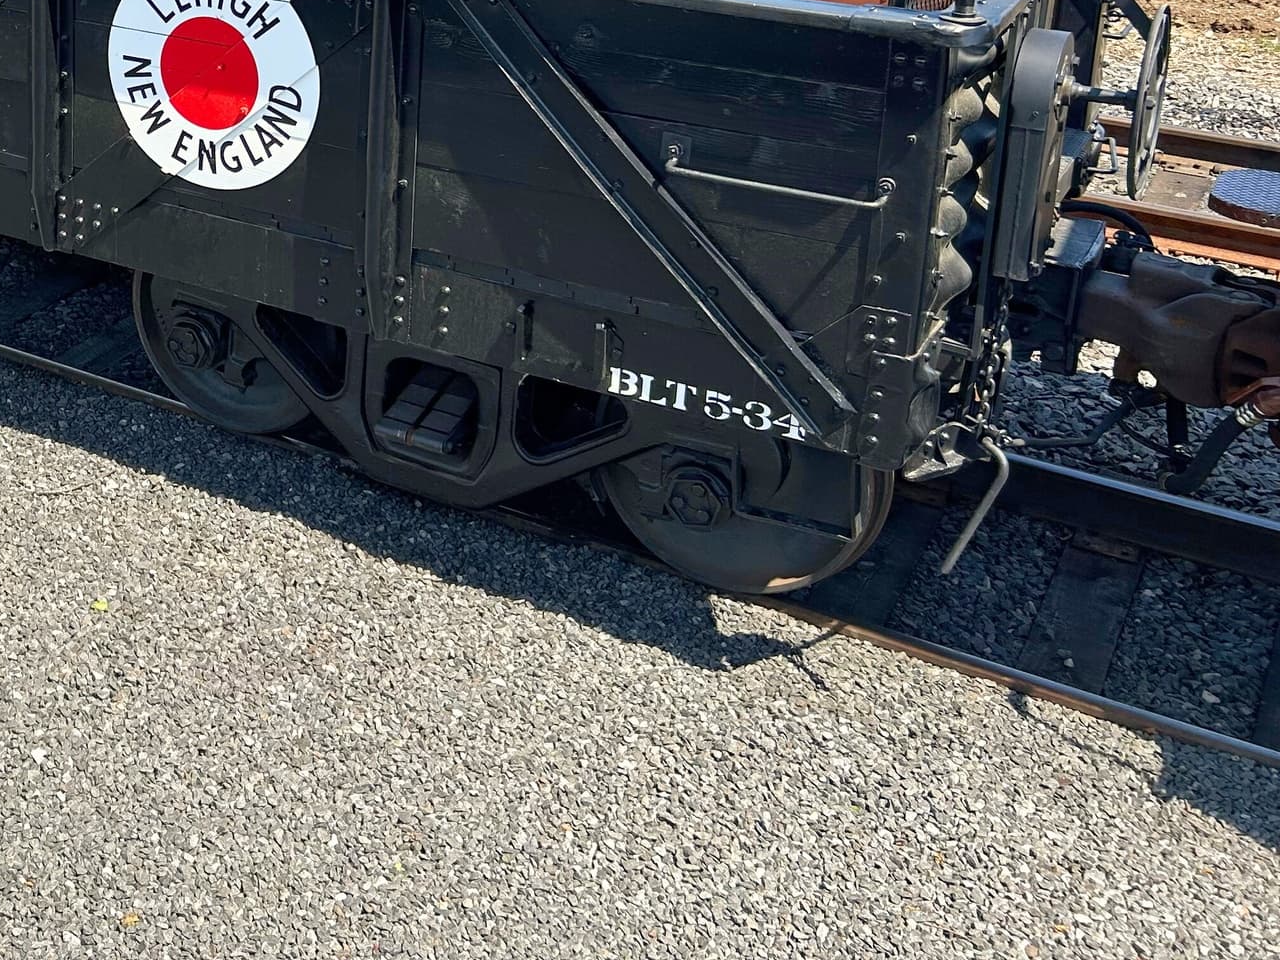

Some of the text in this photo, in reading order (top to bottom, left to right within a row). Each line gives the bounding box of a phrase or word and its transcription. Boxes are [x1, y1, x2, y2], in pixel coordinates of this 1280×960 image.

[122, 54, 302, 174] NEW ENGLAND
[608, 367, 807, 442] BLT 5-34
